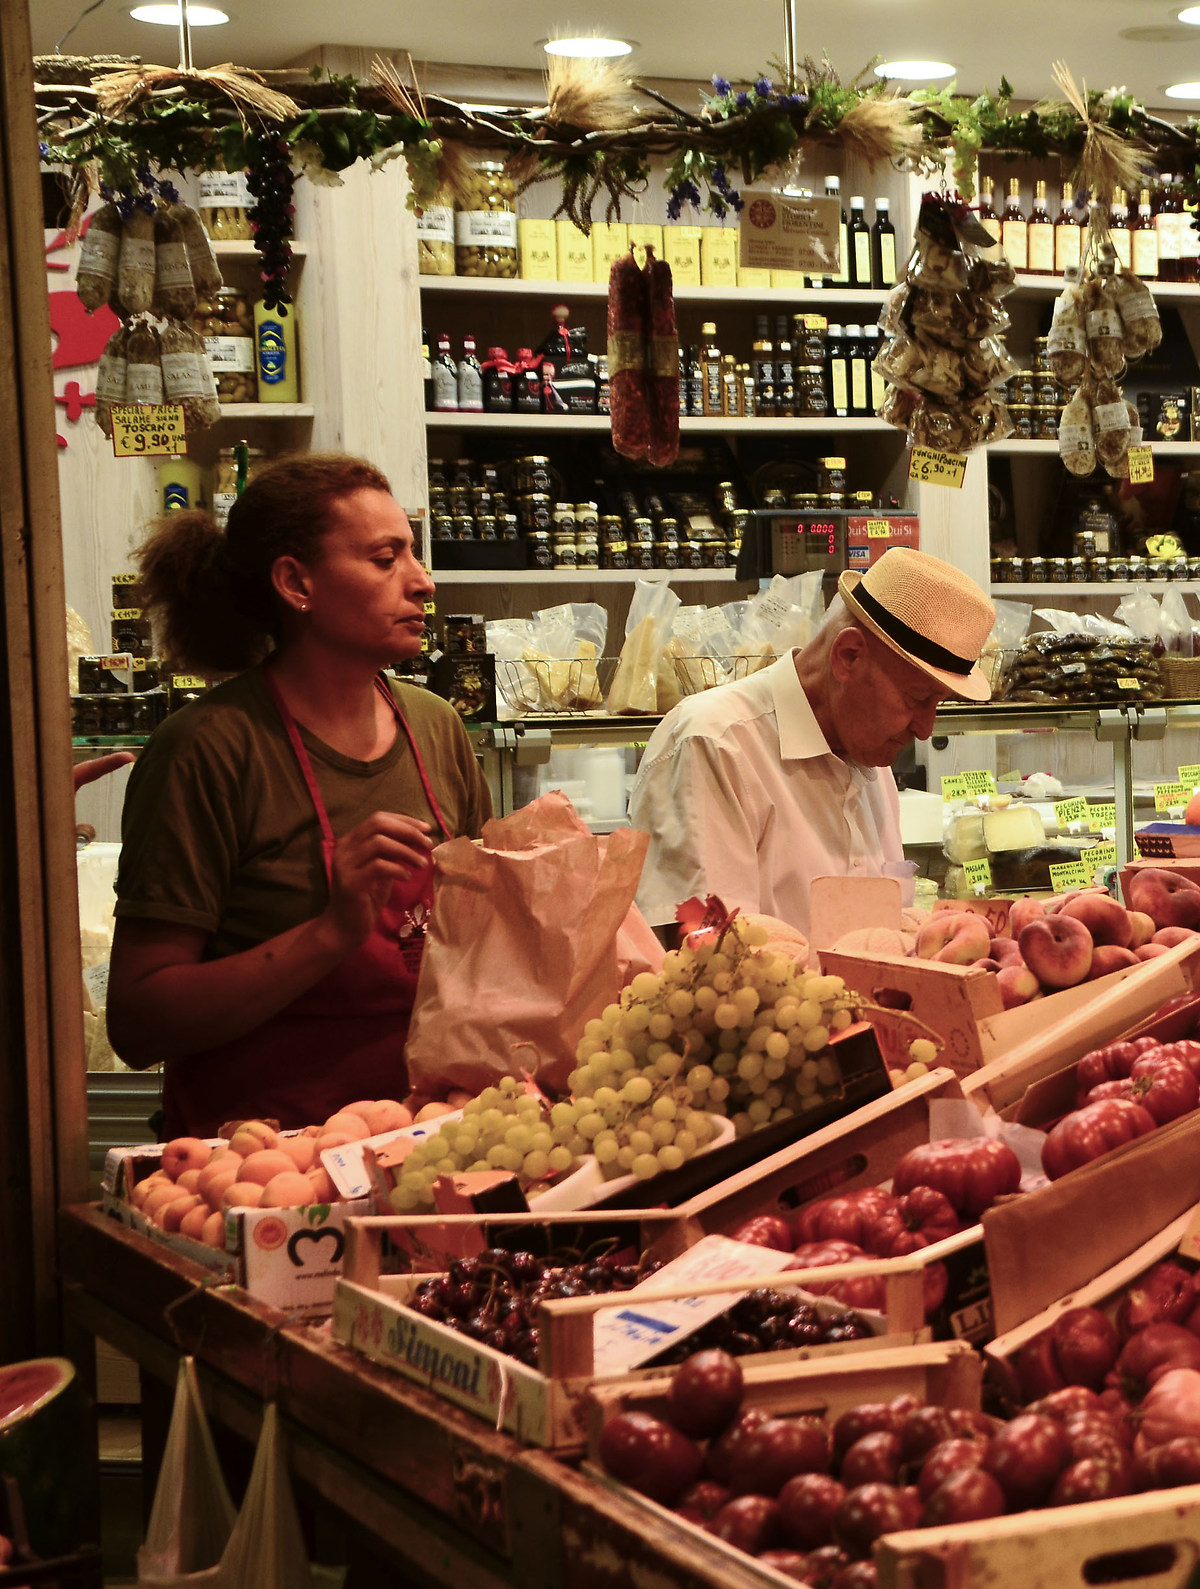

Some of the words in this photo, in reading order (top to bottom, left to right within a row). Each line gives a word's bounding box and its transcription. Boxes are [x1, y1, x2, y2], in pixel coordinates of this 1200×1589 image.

[111, 406, 145, 415] SPECIAL
[150, 405, 179, 414] PRICE
[114, 415, 151, 425] SALAME
[122, 423, 176, 434] TOSCANO
[797, 524, 804, 534] 0
[828, 534, 835, 544] 0
[828, 545, 835, 554] 0
